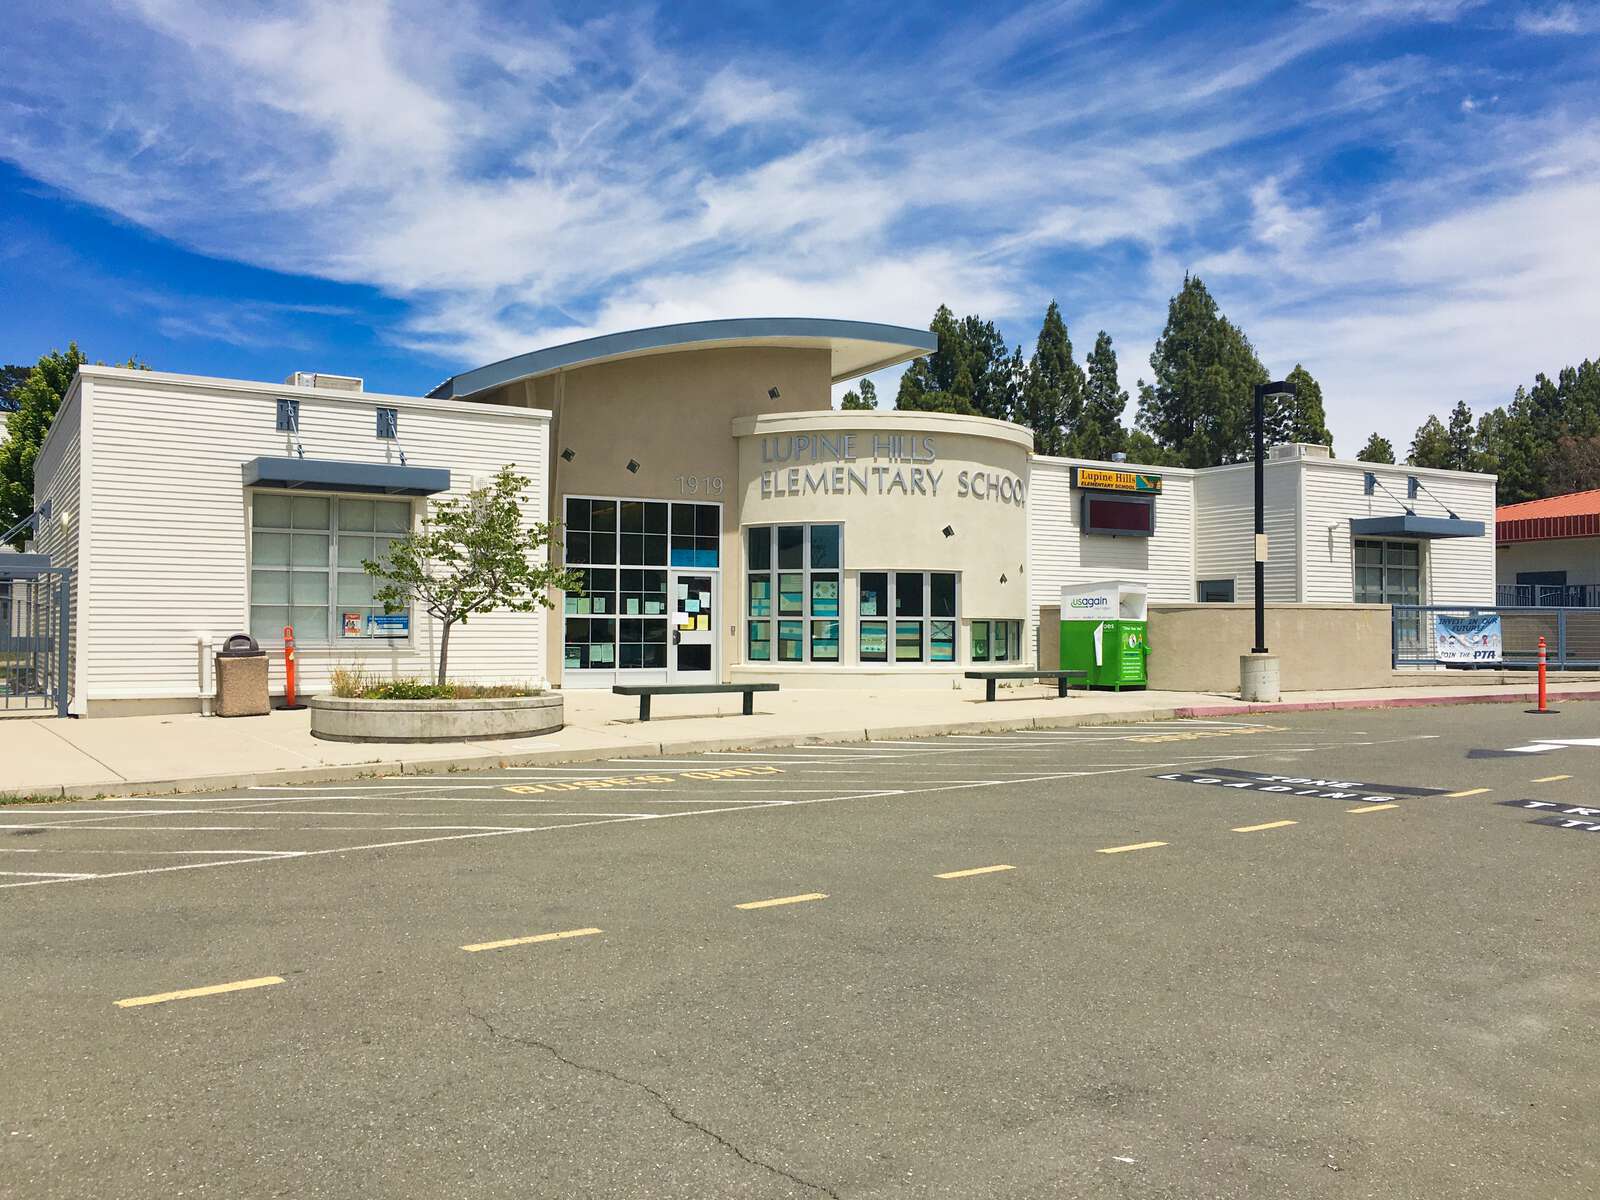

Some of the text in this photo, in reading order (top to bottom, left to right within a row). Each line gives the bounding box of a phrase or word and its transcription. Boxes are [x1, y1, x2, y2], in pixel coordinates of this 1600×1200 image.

[761, 433, 936, 464] LUPINE HILLS
[679, 474, 724, 496] 1919
[760, 466, 943, 499] ELEMENTARY
[1081, 469, 1136, 484] Lupine Hills
[1473, 650, 1497, 660] PTA
[502, 766, 786, 794] BUSES ONLY
[1157, 774, 1396, 802] LOADING
[1256, 776, 1364, 788] ZONE
